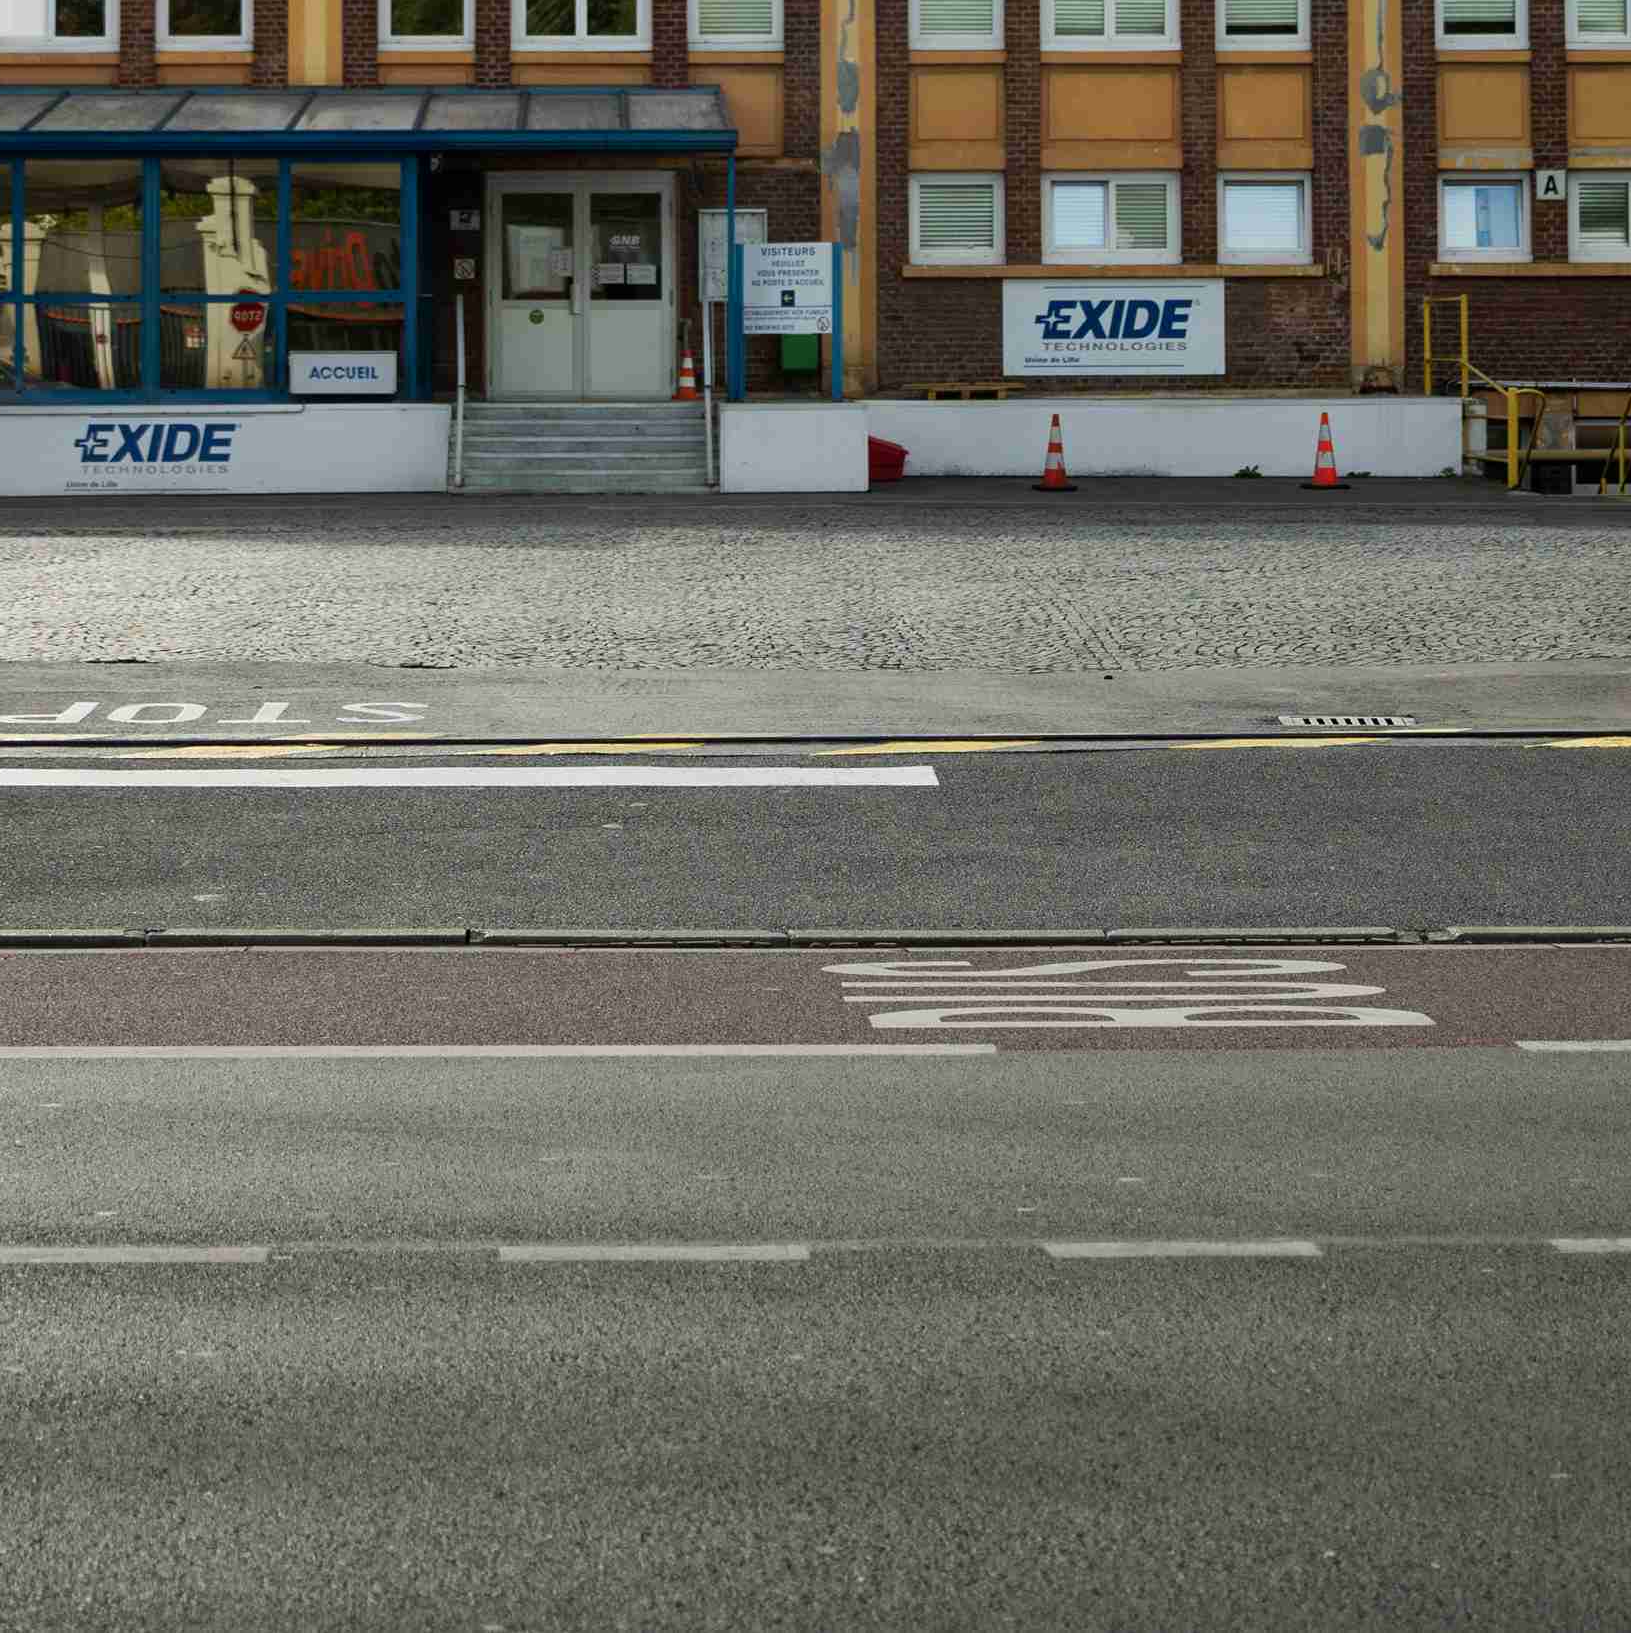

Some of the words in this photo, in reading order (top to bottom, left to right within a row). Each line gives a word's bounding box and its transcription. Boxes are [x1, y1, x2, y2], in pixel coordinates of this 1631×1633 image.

[1543, 175, 1559, 195] A
[760, 247, 817, 256] VISITEURS
[1035, 300, 1193, 339] EXIDE
[1042, 342, 1188, 351] TECHNOLOGIES
[308, 365, 379, 380] ACCUEIL
[74, 424, 236, 462] EXIDE
[81, 465, 229, 474] TECHNOLOGIES
[821, 959, 1437, 1028] BUS
